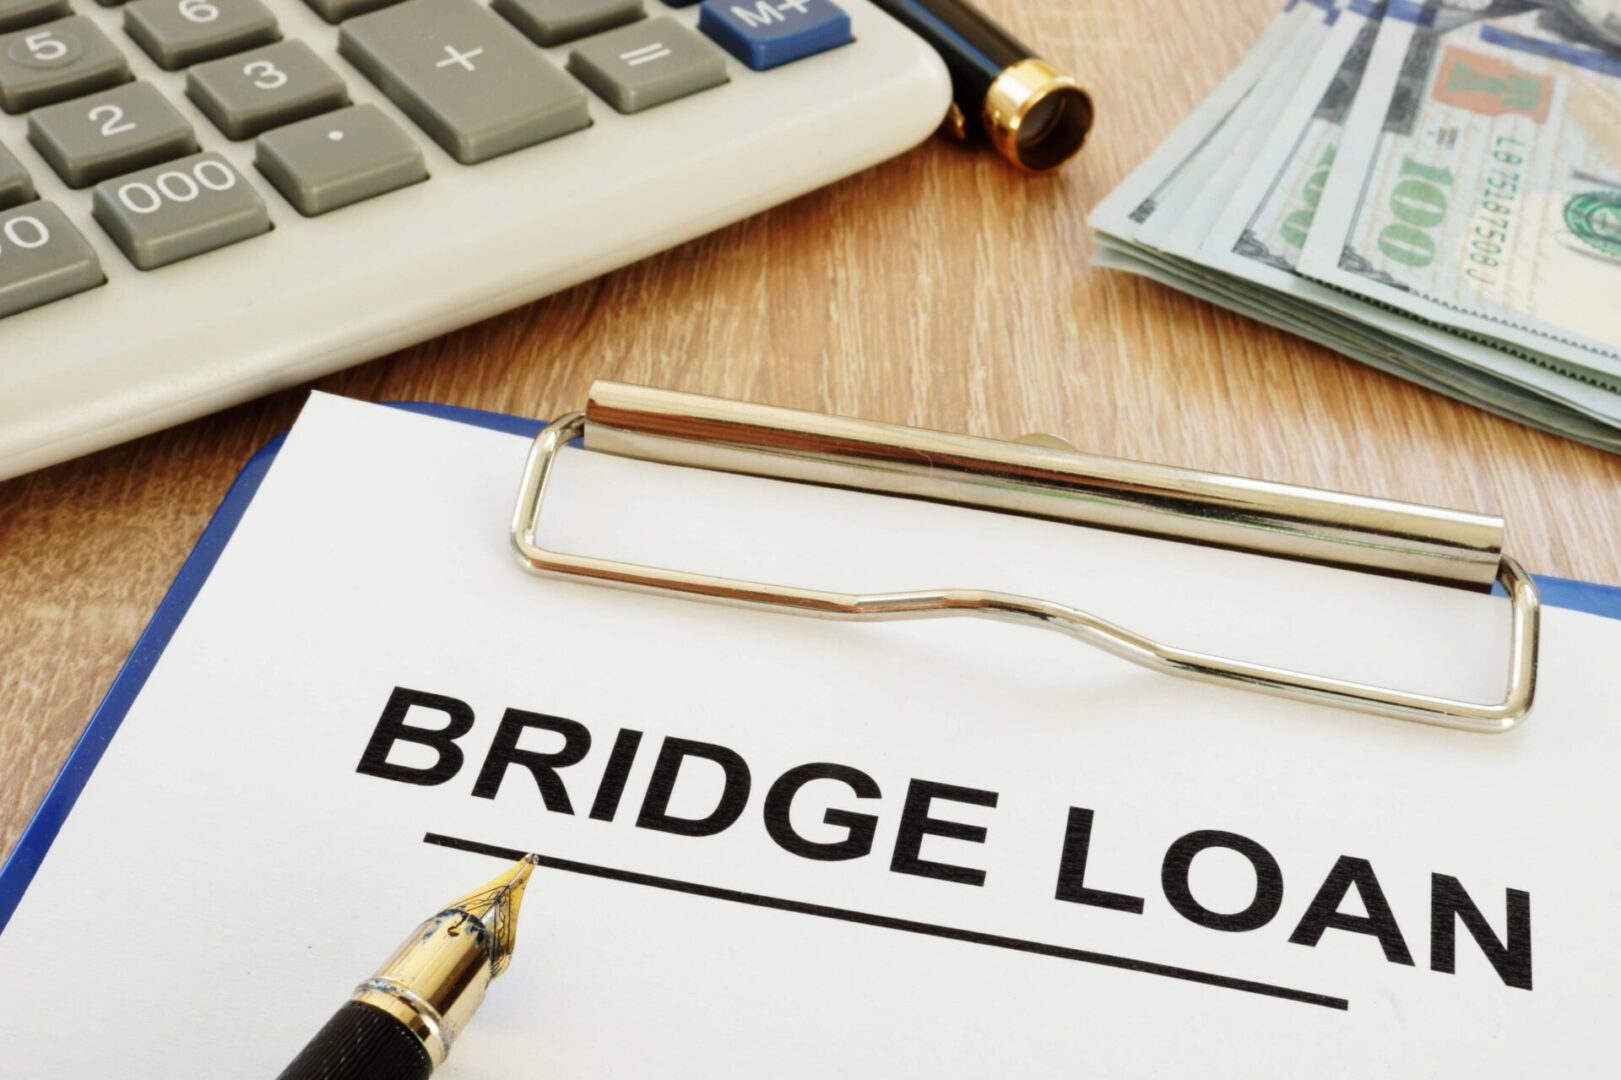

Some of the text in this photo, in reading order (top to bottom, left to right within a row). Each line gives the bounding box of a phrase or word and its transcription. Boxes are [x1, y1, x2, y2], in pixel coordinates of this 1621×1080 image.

[178, 0, 219, 23] 6
[25, 31, 67, 60] 5
[243, 60, 288, 89] 3
[88, 105, 136, 136] 2
[118, 159, 236, 214] 000
[1376, 157, 1454, 268] 100
[357, 687, 1532, 990] BRIDGE LOAN
